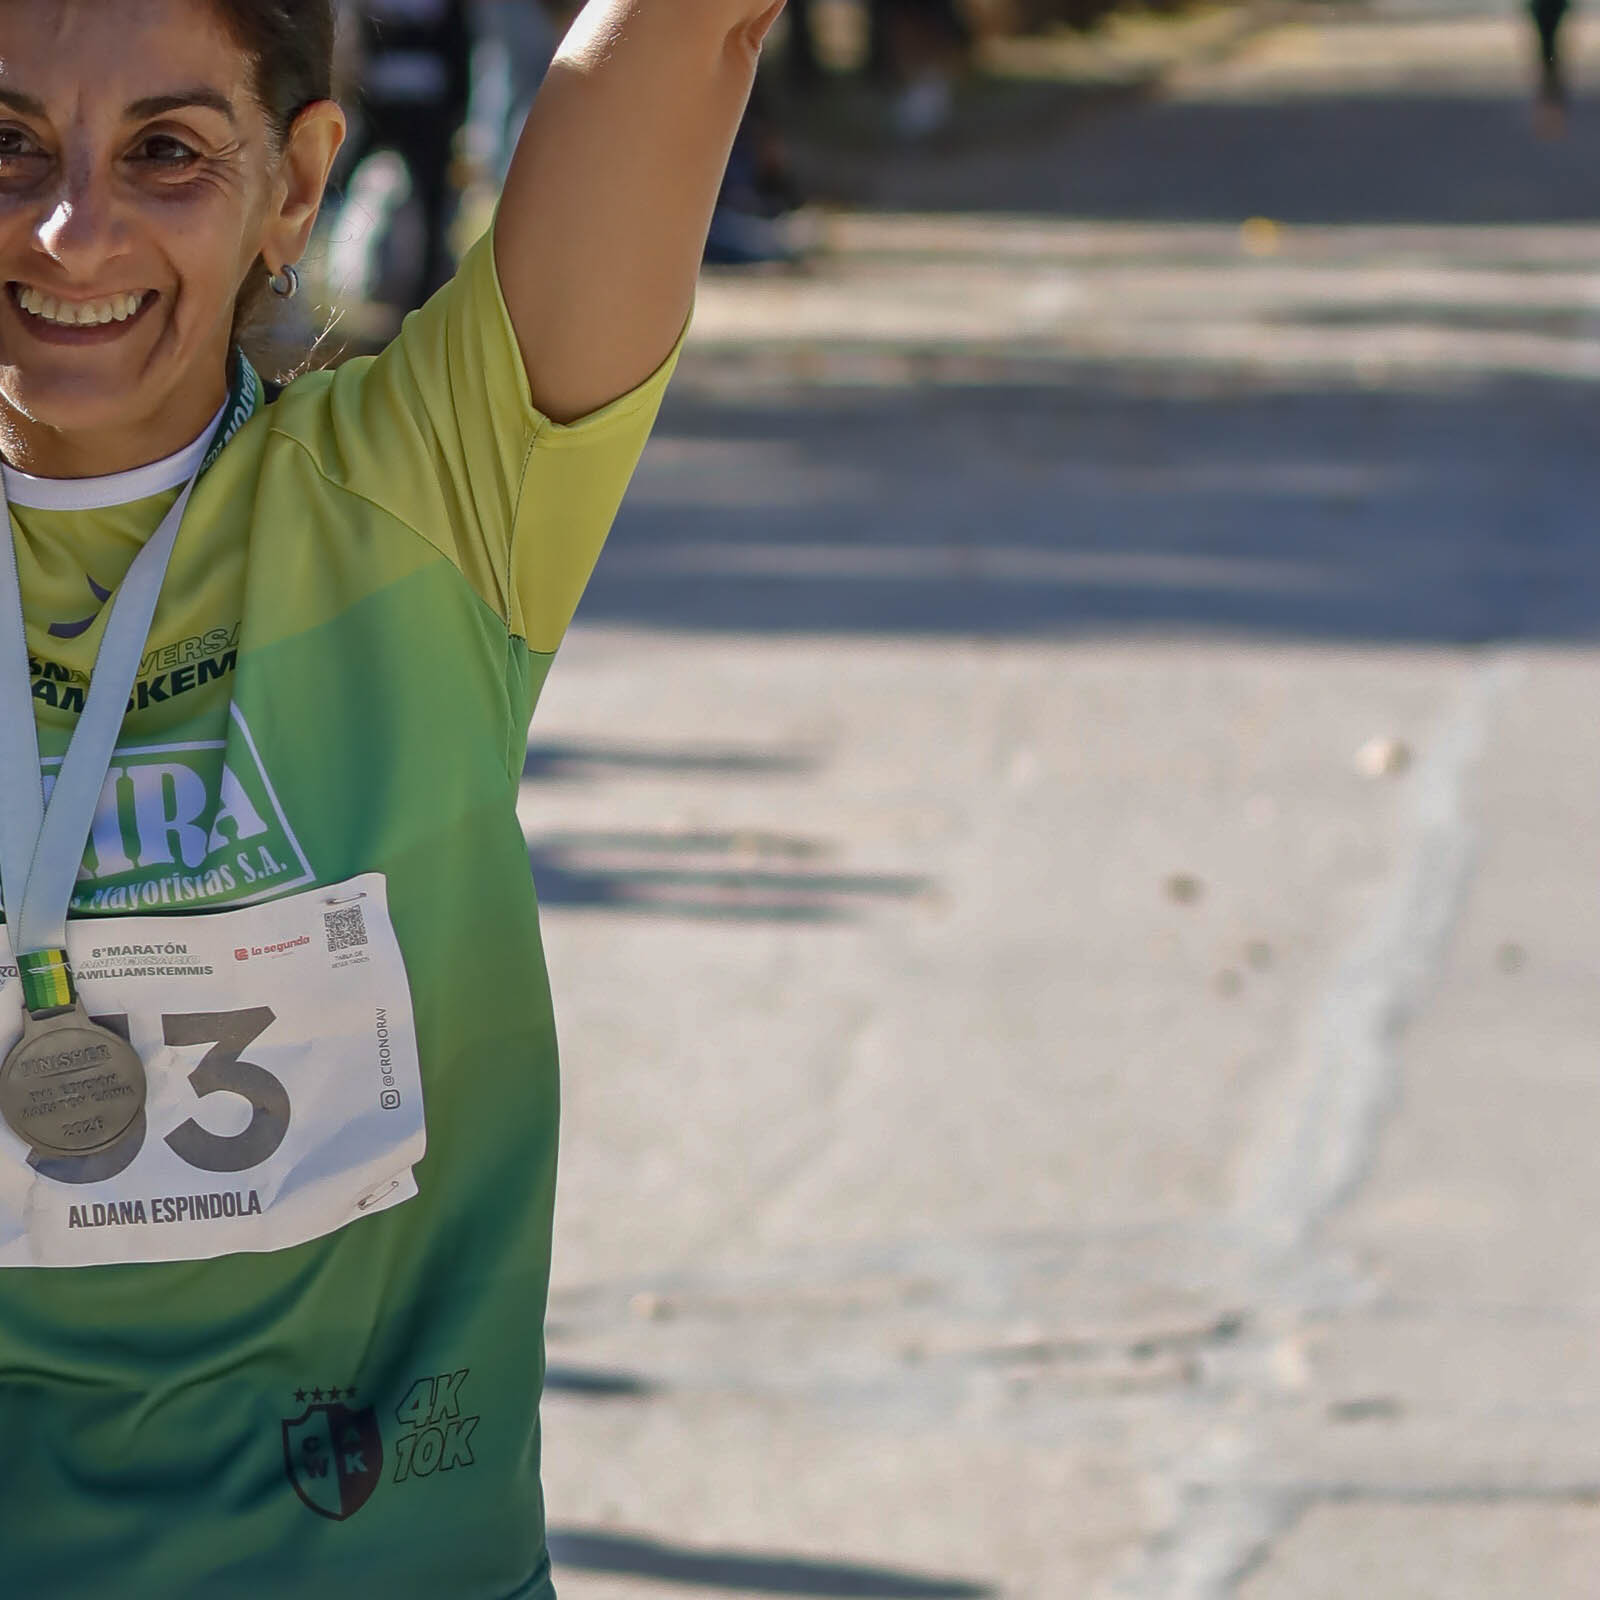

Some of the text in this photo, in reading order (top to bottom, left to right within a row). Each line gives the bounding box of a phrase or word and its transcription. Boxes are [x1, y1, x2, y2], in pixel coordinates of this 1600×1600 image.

[236, 845, 288, 884] S.A.
[263, 935, 311, 953] segunda
[71, 965, 214, 981] AWILLIAMSKEMMIS
[375, 1007, 396, 1088] @CRONORAV
[68, 1189, 263, 1229] ALDANA ESPINDOLA
[395, 1367, 471, 1429] 4K
[393, 1415, 481, 1484] 10K
